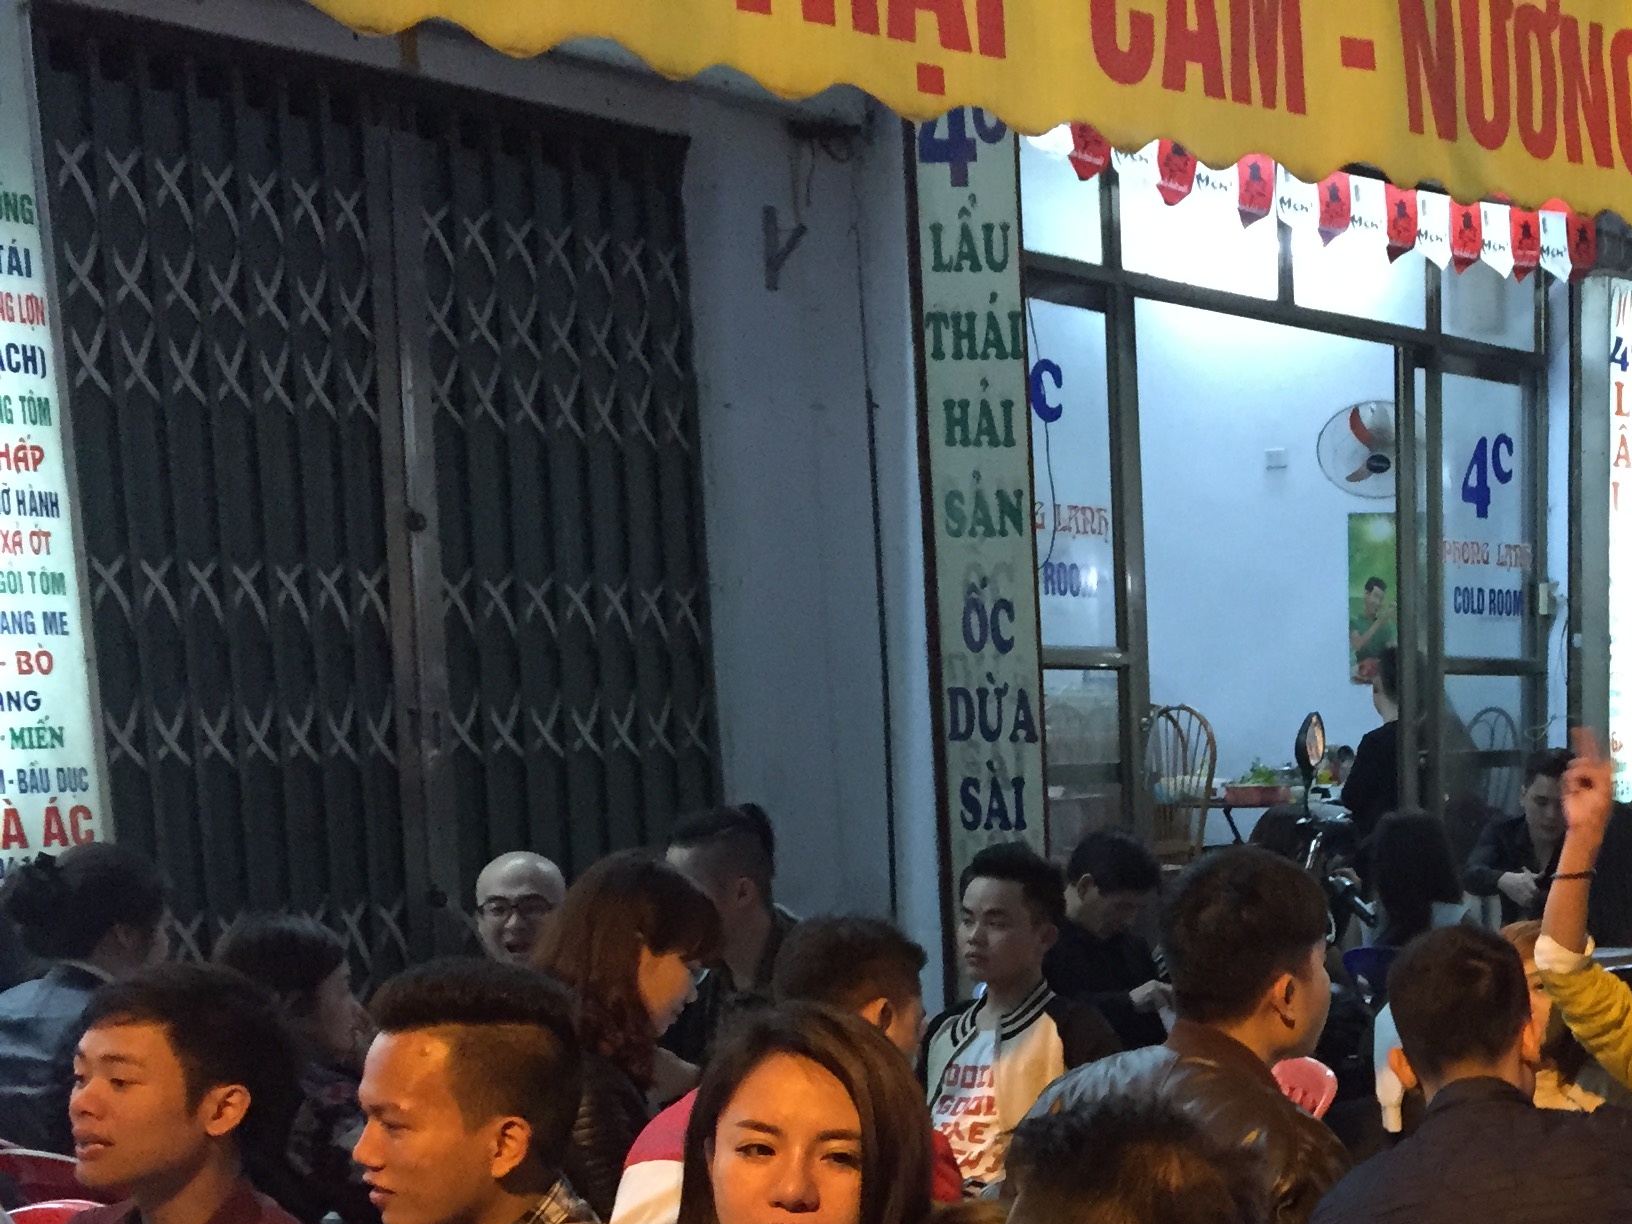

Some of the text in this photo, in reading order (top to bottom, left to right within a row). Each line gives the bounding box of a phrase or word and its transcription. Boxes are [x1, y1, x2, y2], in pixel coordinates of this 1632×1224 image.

[0, 192, 34, 225] NG
[928, 193, 1011, 273] LẨU
[925, 290, 1024, 361] THÁI
[19, 389, 52, 427] TÔM
[942, 377, 1017, 448] HẢI
[1461, 433, 1515, 519] 4C
[15, 483, 60, 518] HÀNH
[944, 469, 1024, 538] SẢN
[27, 566, 66, 596] TÔM
[1043, 562, 1097, 597] ROO
[1453, 586, 1524, 617] COLD ROOM
[42, 611, 70, 636] ME
[961, 576, 1016, 654] ỐC
[15, 643, 54, 675] BÒ
[947, 671, 1040, 744] DỪA
[9, 715, 64, 749] MIẾN
[959, 760, 1028, 832] SÀI
[42, 796, 95, 849] ÁC
